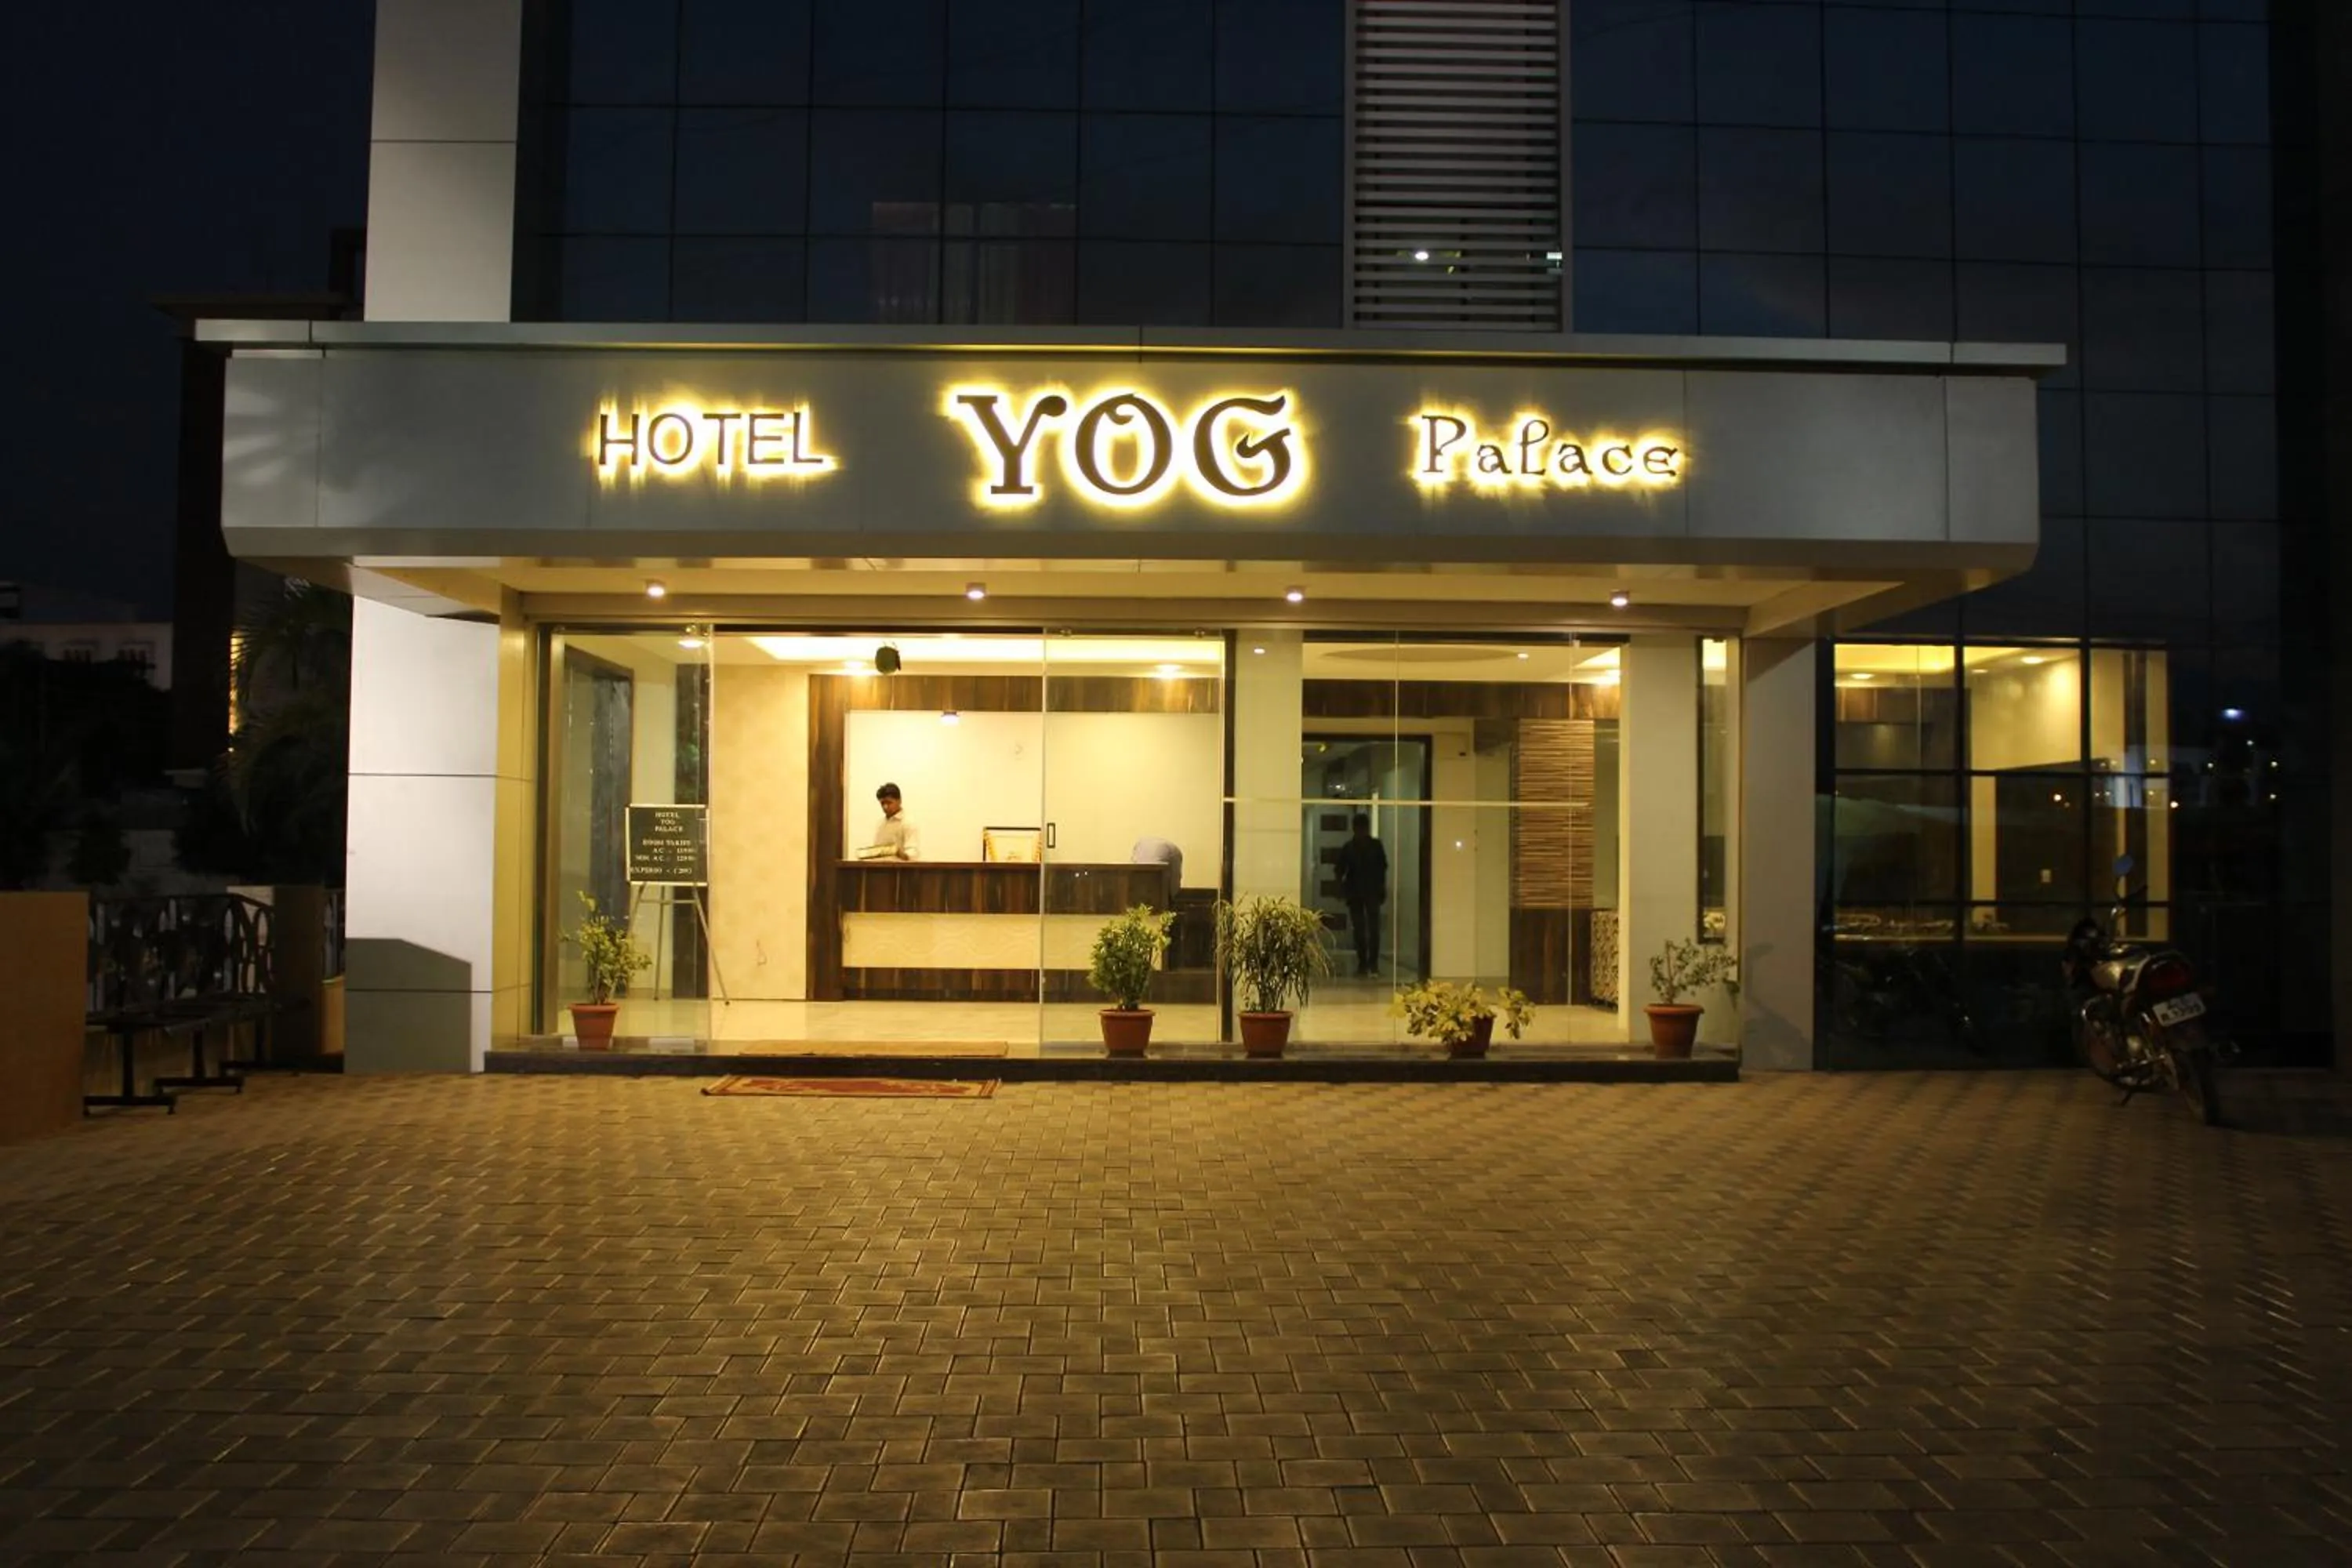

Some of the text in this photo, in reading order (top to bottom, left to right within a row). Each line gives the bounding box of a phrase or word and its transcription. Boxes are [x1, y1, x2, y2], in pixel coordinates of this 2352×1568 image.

[599, 394, 1678, 495] HOTEL YOG Palace
